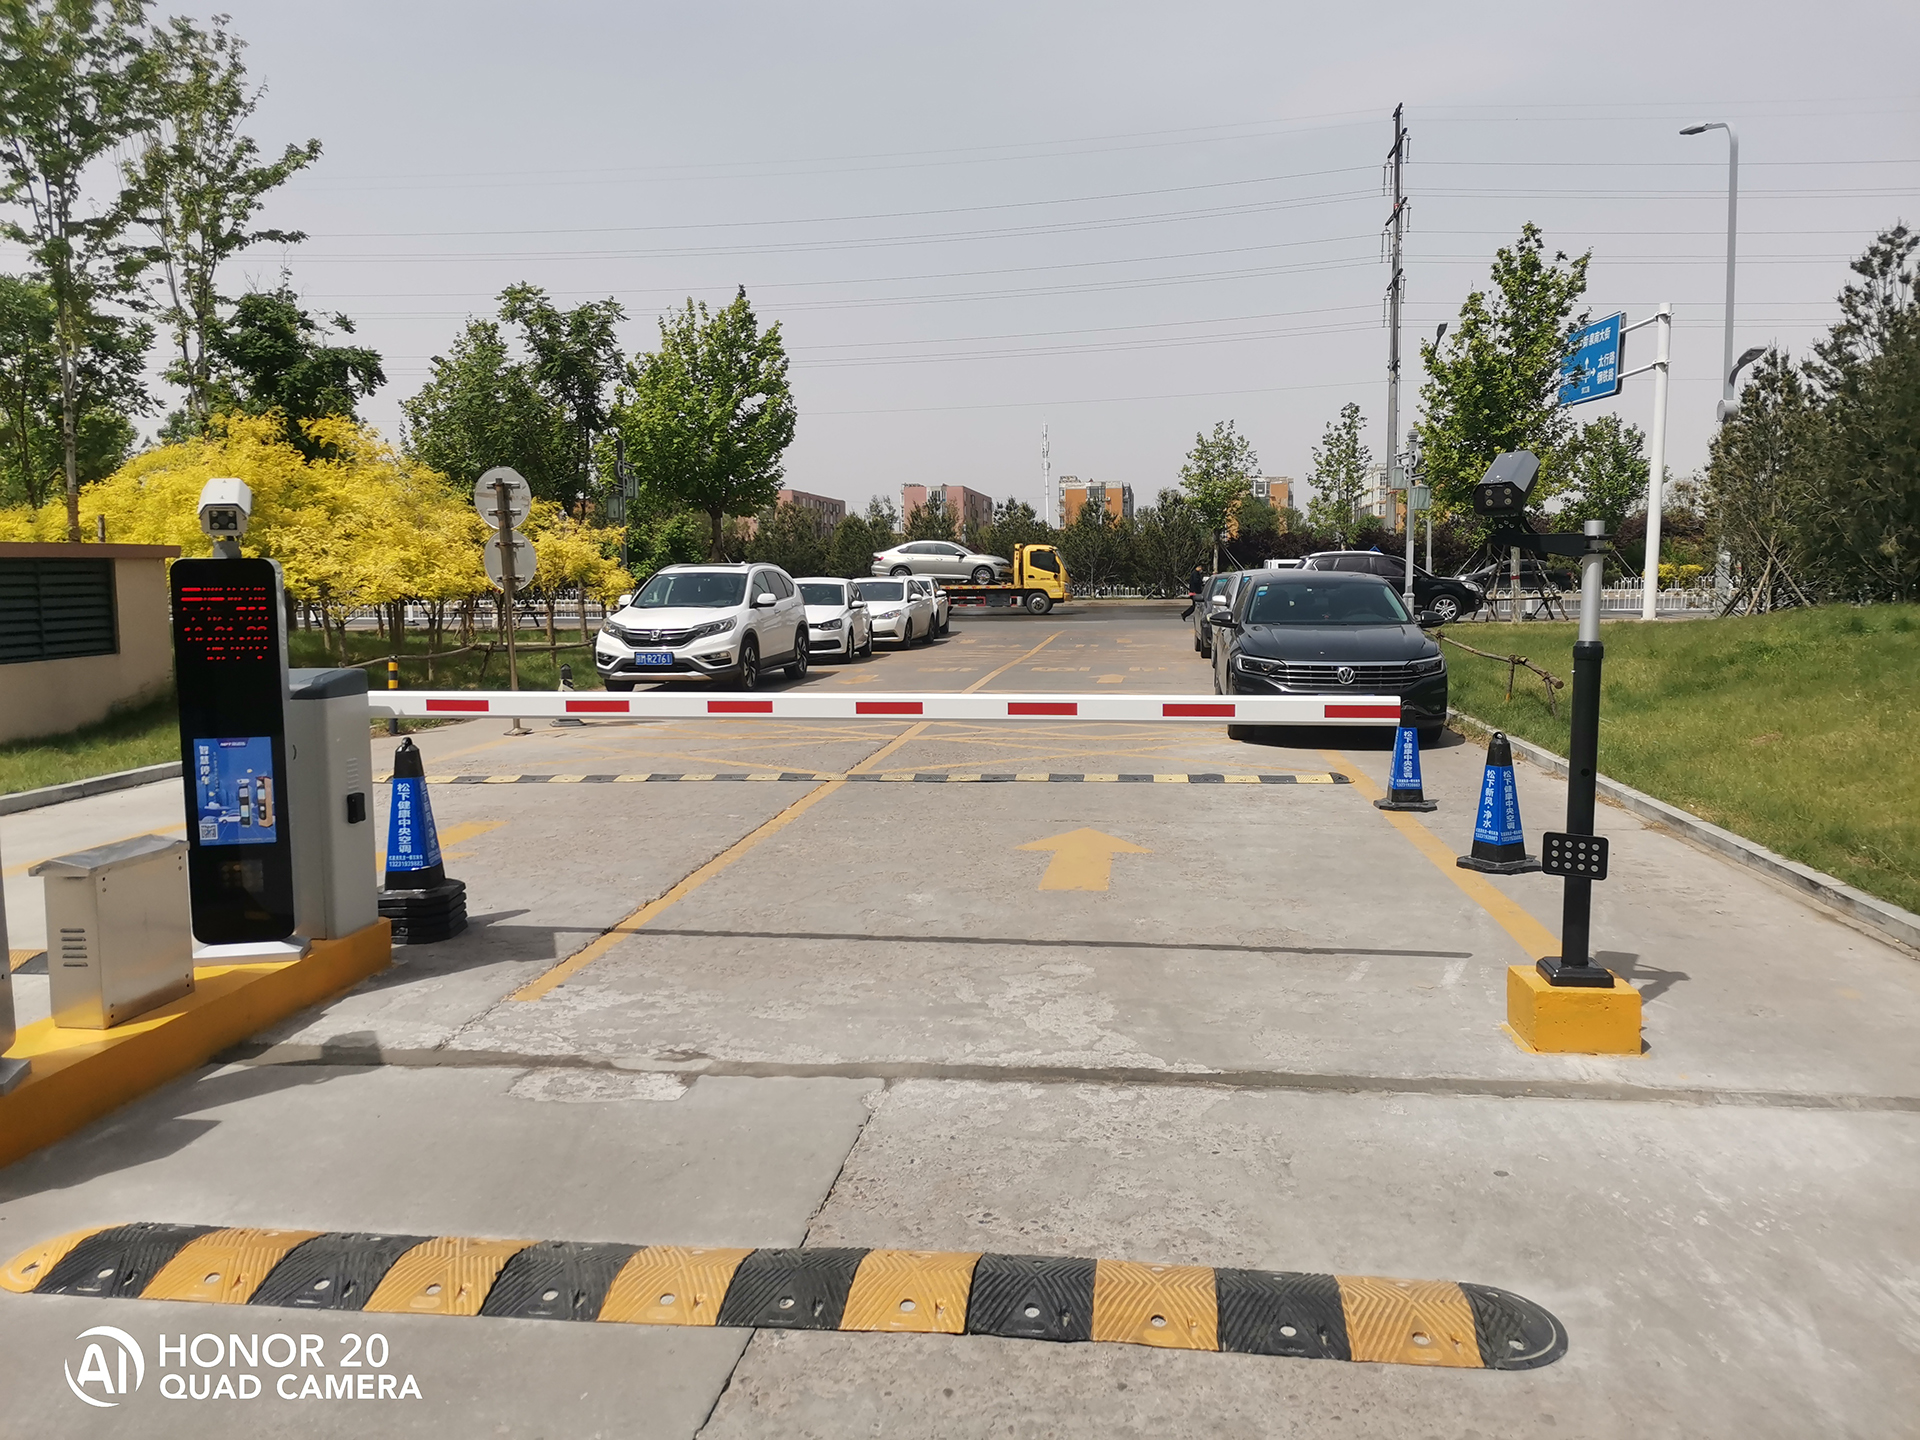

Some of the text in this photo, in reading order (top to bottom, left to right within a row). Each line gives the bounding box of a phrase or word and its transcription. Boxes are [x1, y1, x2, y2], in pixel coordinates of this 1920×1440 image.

[199, 745, 210, 785] 智慧停车
[1403, 730, 1413, 779] 松下健康中央空调
[397, 783, 412, 854] 松下健康中央空调
[1503, 770, 1516, 830] 松下健康中央空调
